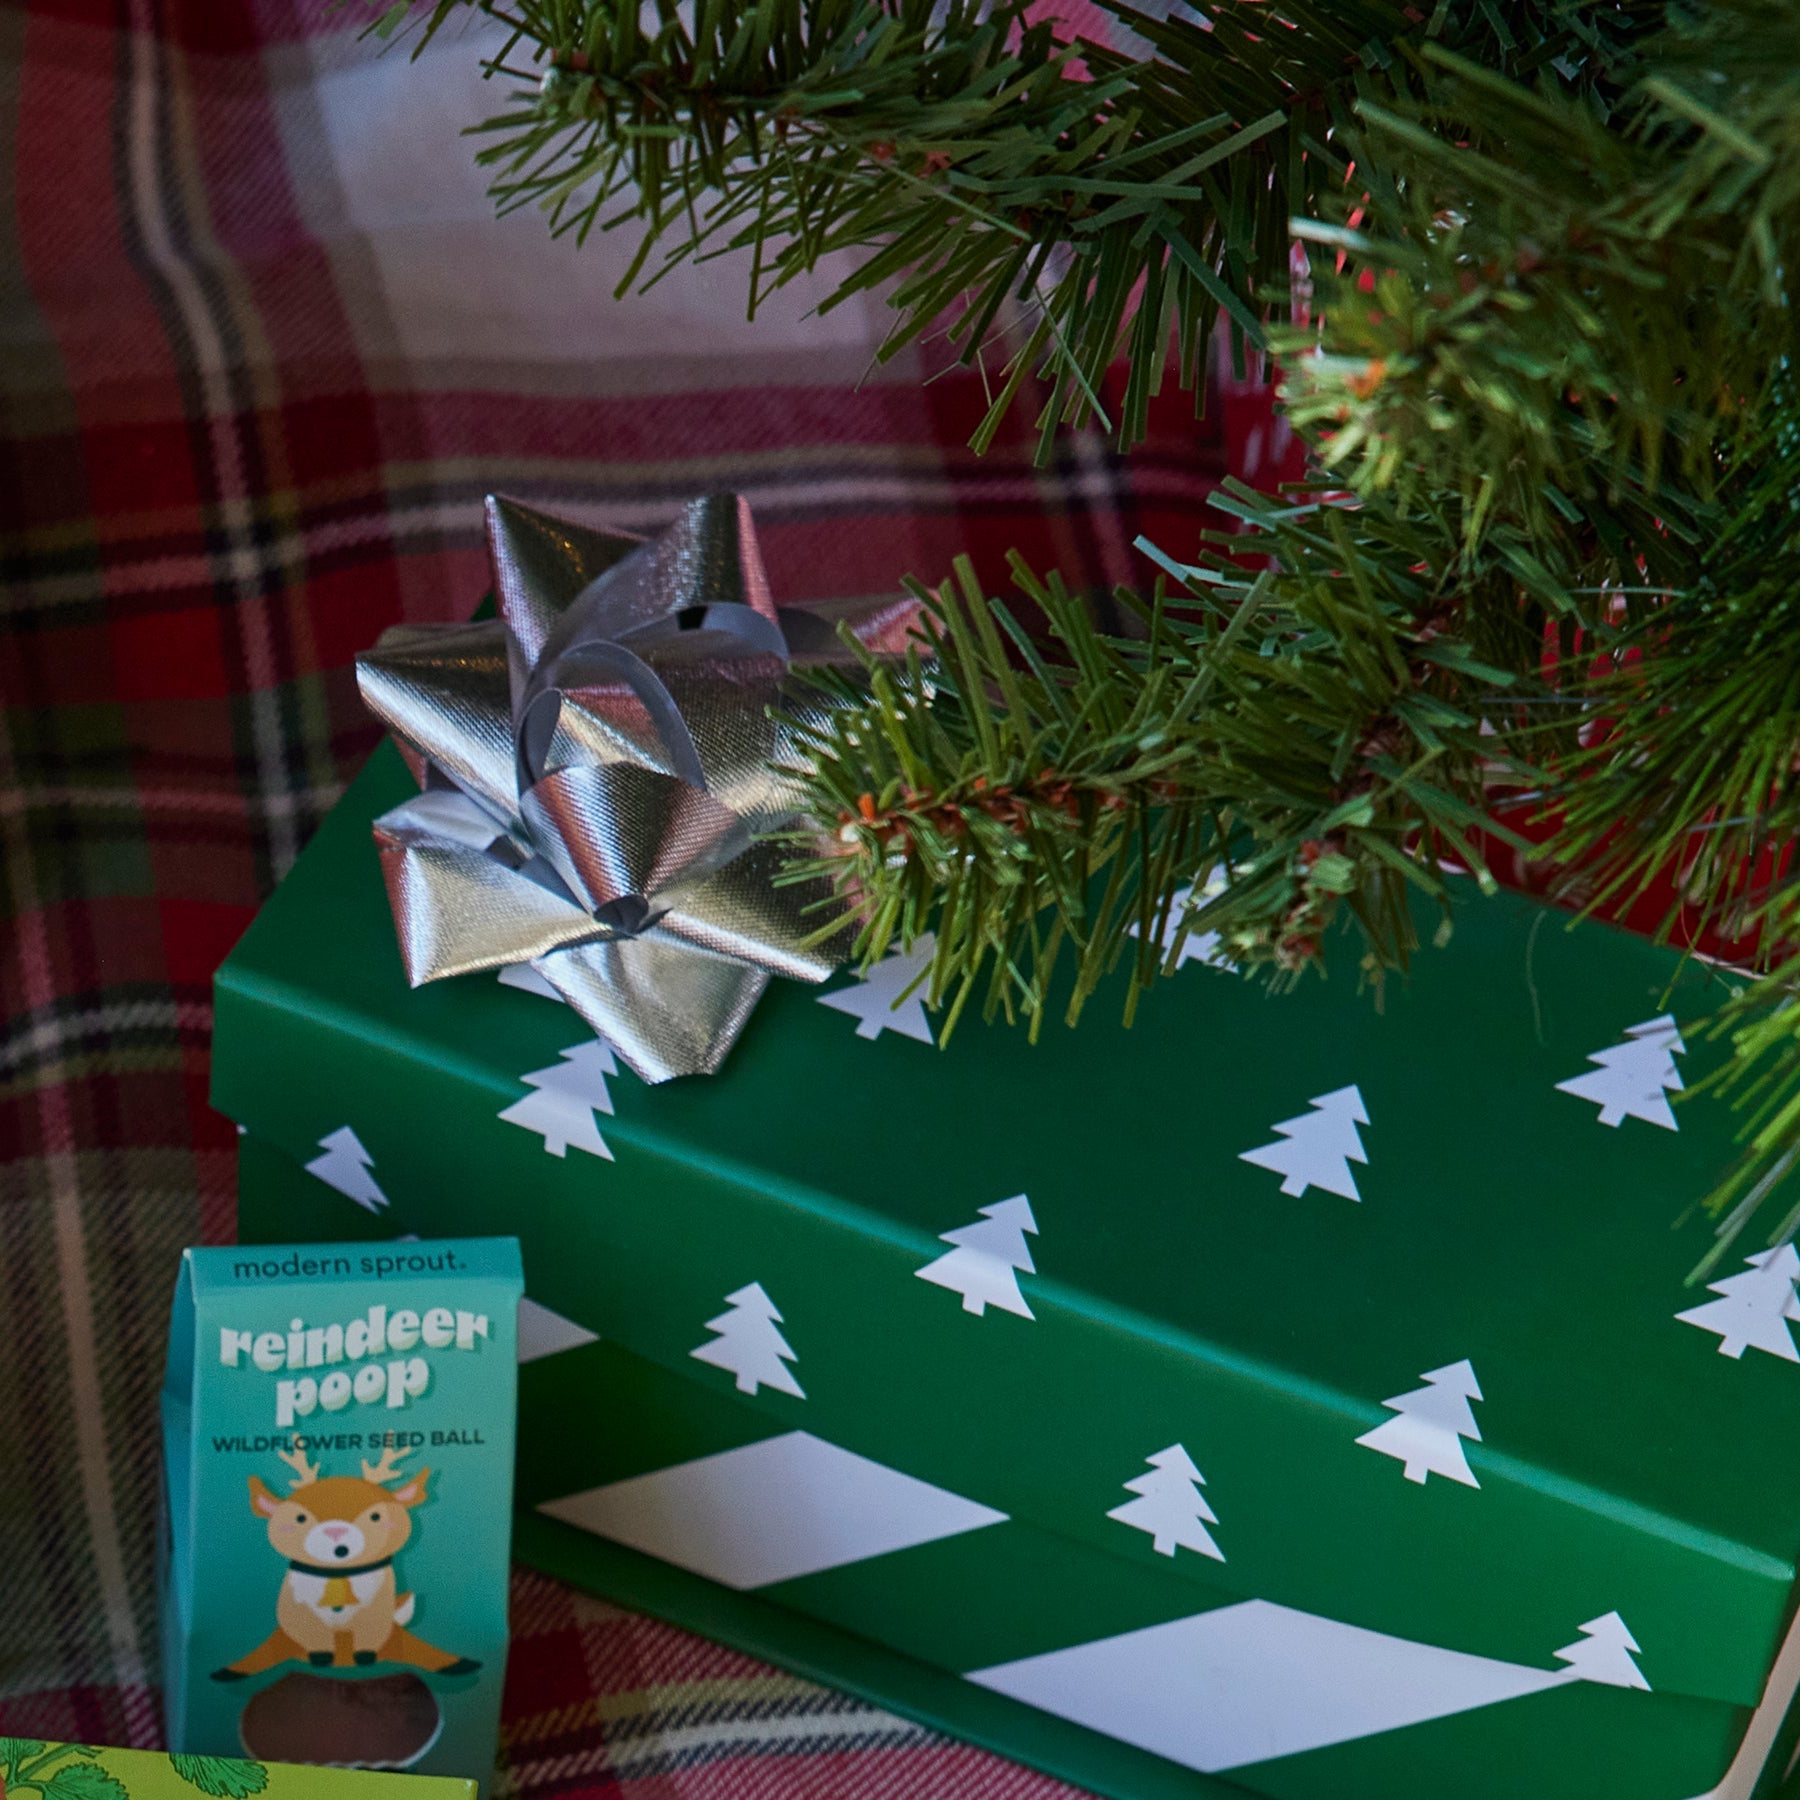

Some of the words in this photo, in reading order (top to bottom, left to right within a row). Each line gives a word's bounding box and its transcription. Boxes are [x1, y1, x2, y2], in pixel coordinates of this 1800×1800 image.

[234, 1253, 349, 1279] modern
[220, 1305, 488, 1372] reindeer
[275, 1357, 430, 1427] poop
[212, 1434, 361, 1453] WILDFLOWER
[368, 1431, 424, 1449] SEED
[430, 1430, 485, 1446] BALL
